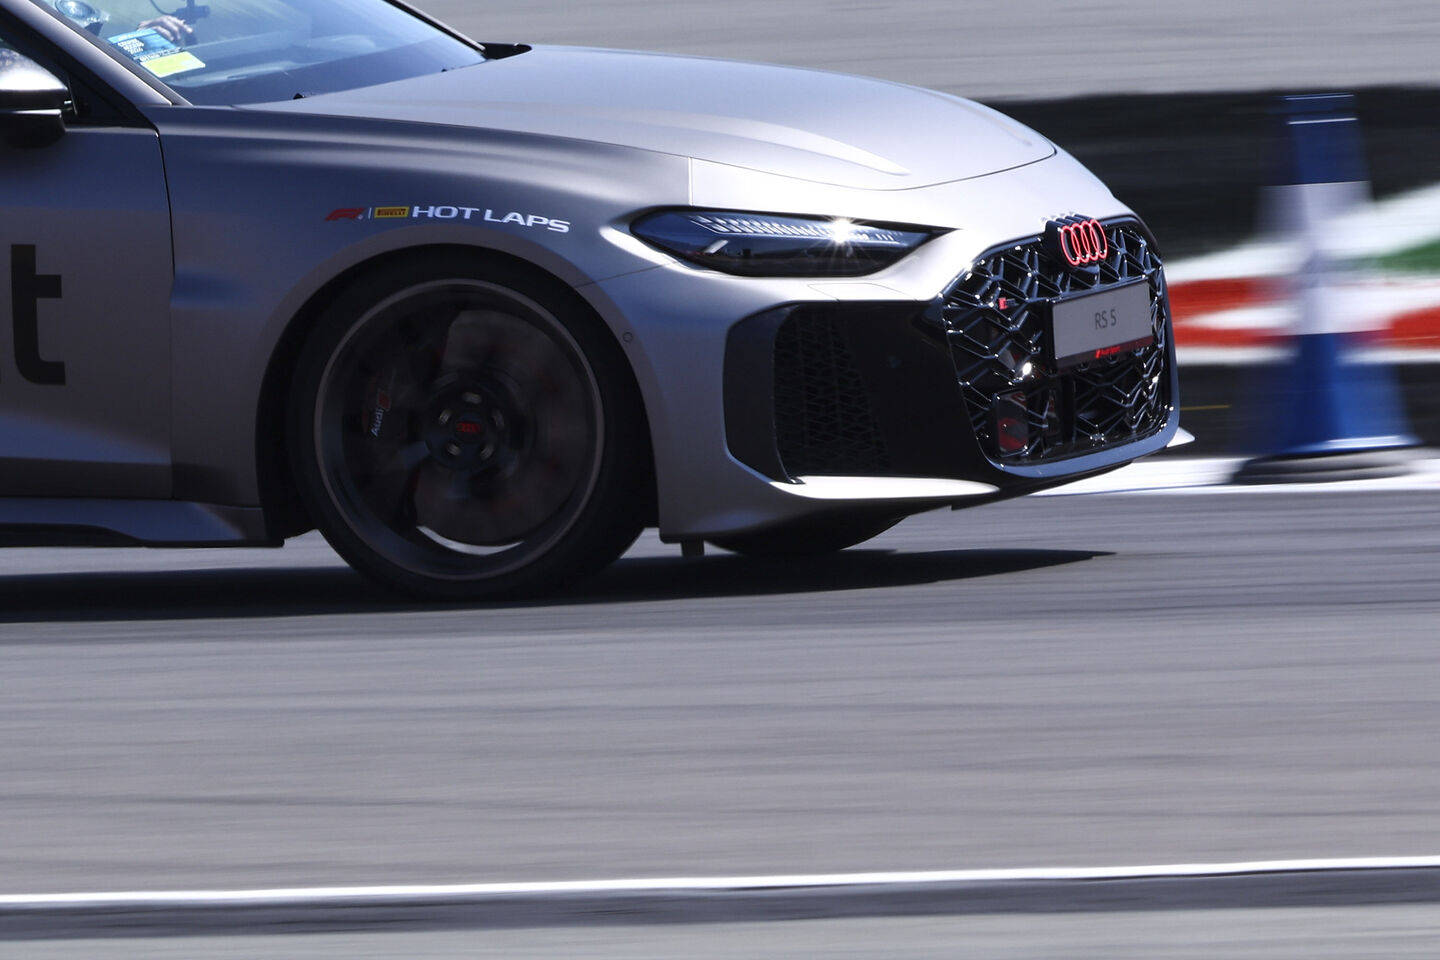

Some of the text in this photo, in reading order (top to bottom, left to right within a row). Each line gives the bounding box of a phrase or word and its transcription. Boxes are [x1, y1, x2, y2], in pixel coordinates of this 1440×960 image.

[412, 206, 480, 219] HOT
[484, 209, 571, 233] LAPS
[1094, 308, 1117, 329] RS 5
